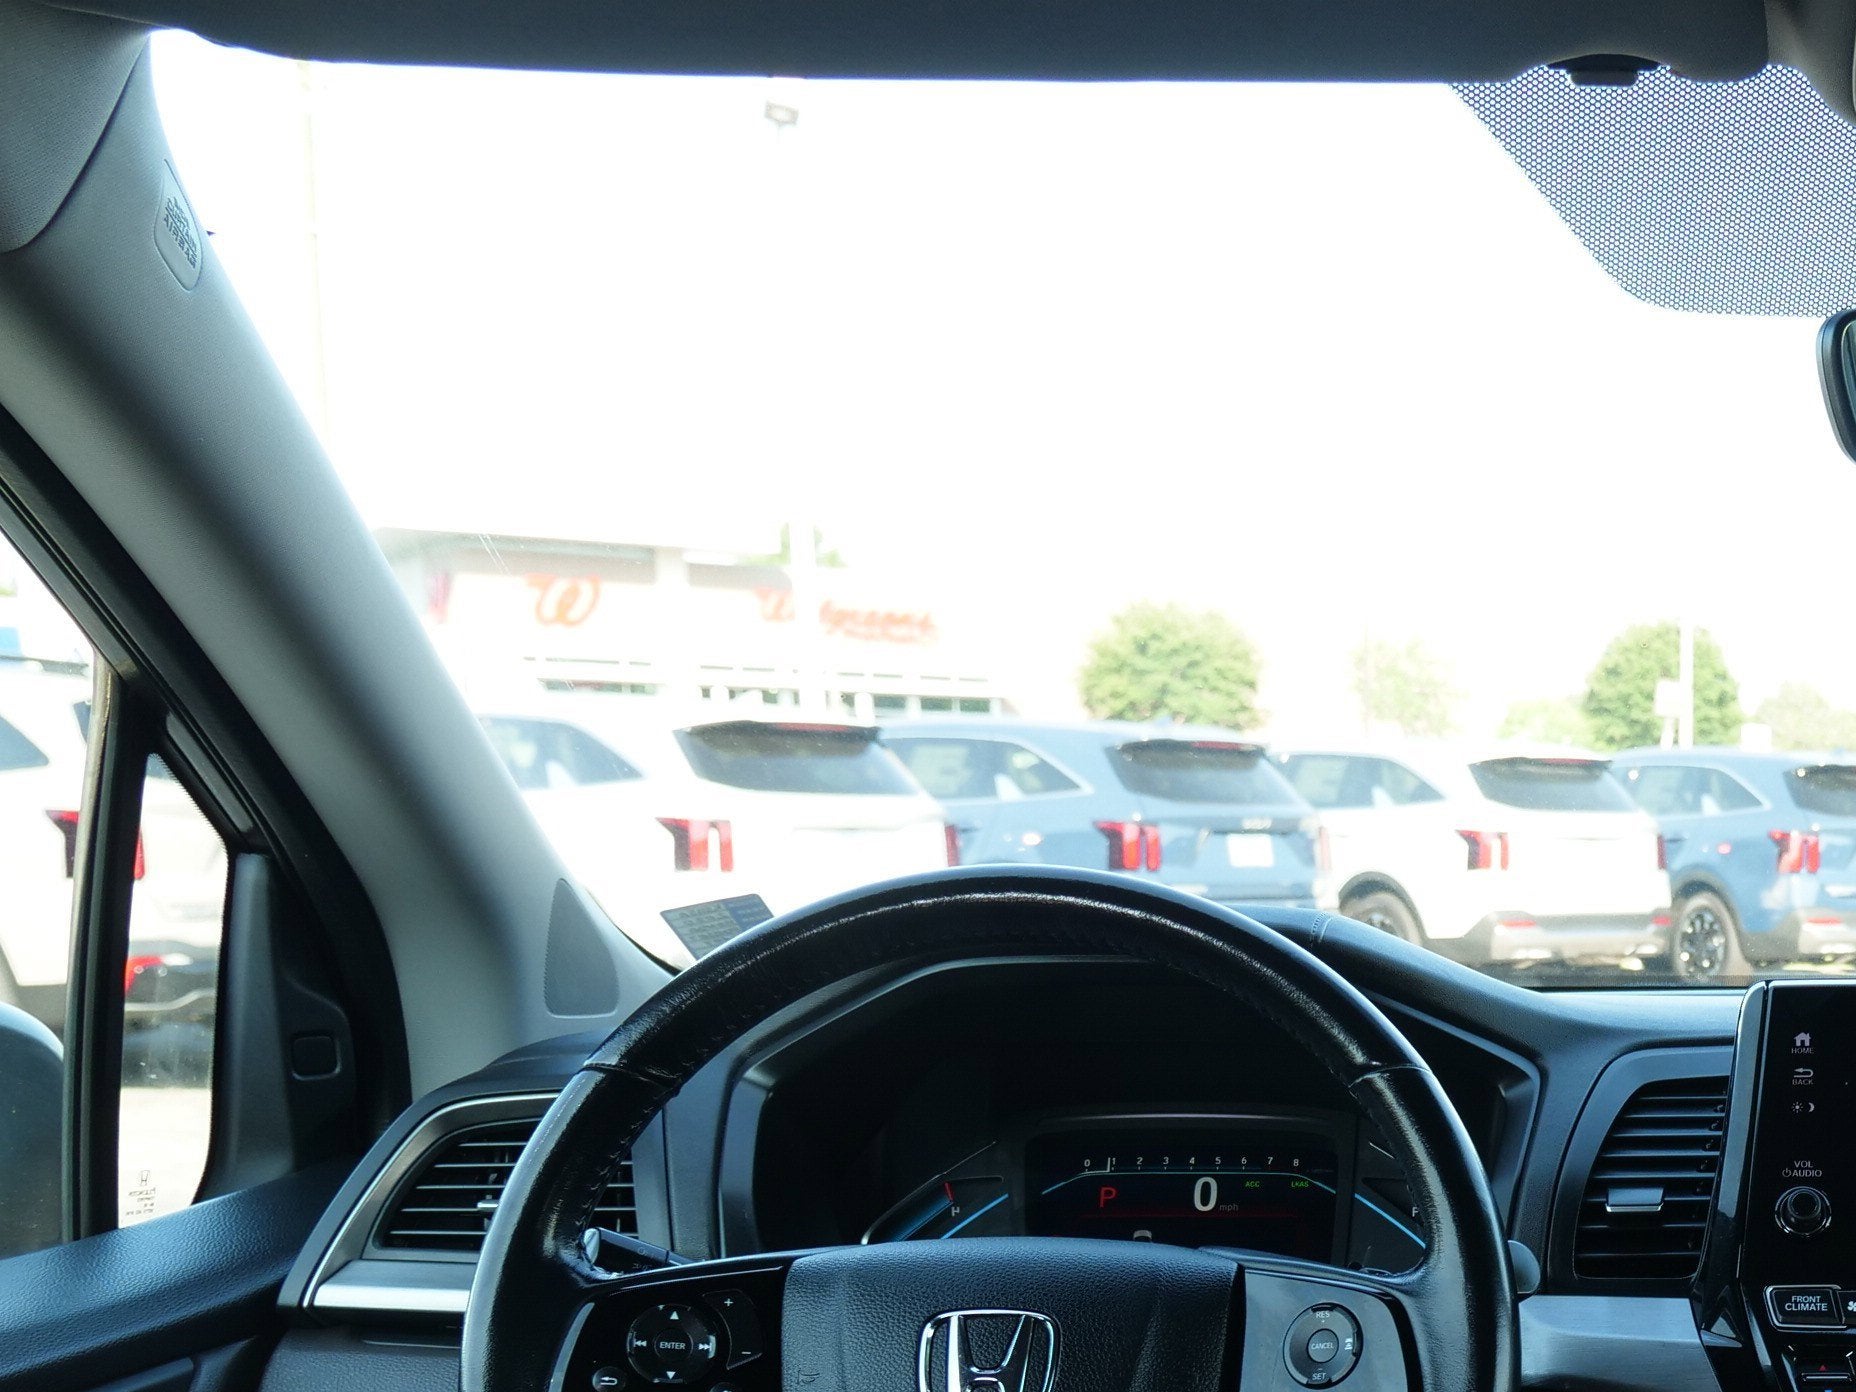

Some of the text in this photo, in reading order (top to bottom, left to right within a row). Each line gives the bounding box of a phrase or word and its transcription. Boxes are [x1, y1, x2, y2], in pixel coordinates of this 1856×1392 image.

[1792, 1078, 1814, 1086] BACK
[1084, 1158, 1091, 1168] 0
[1136, 1156, 1144, 1165] 2
[1162, 1156, 1170, 1165] 3
[1188, 1156, 1196, 1165] 4
[1214, 1156, 1222, 1165] 5
[1240, 1156, 1248, 1165] 6
[1268, 1156, 1274, 1165] 7
[1292, 1158, 1300, 1167] 8
[1794, 1160, 1812, 1168] VOL
[1792, 1169, 1822, 1178] AUDIO
[1244, 1180, 1260, 1188] ACC
[1290, 1180, 1309, 1188] LKAS
[1100, 1186, 1118, 1208] P
[1193, 1176, 1238, 1212] 0 mph
[1784, 1302, 1828, 1312] CLIMATE
[660, 1342, 686, 1350] ENTER
[1310, 1342, 1334, 1350] CANCEL
[1312, 1372, 1326, 1380] SET
